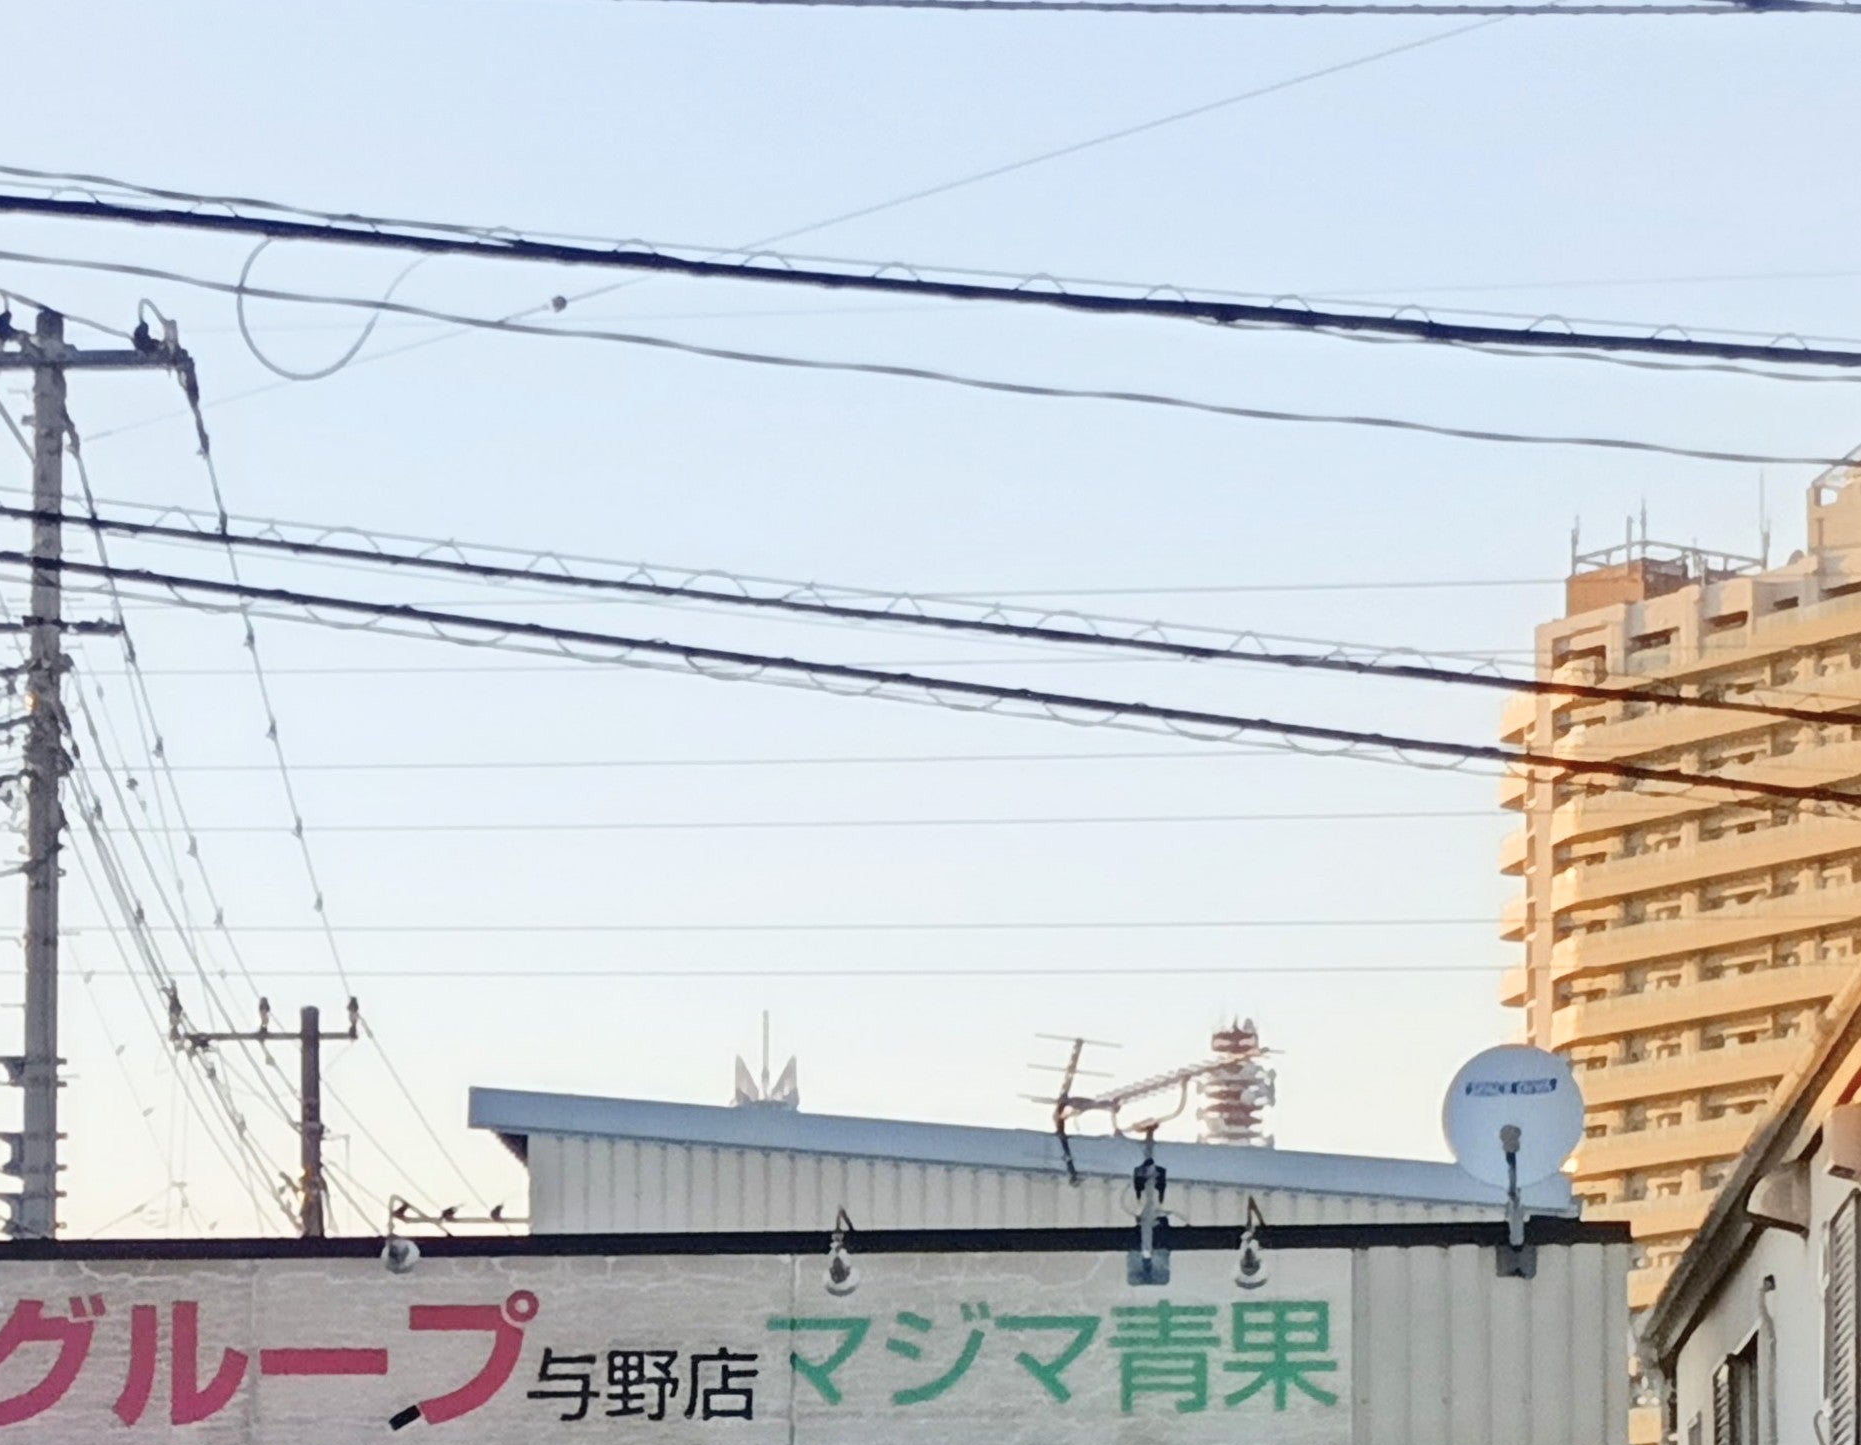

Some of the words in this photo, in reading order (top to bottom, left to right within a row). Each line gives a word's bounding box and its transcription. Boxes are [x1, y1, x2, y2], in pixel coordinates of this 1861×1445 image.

[526, 1345, 760, 1422] 与野店
[765, 1299, 1338, 1414] マジマ青果
